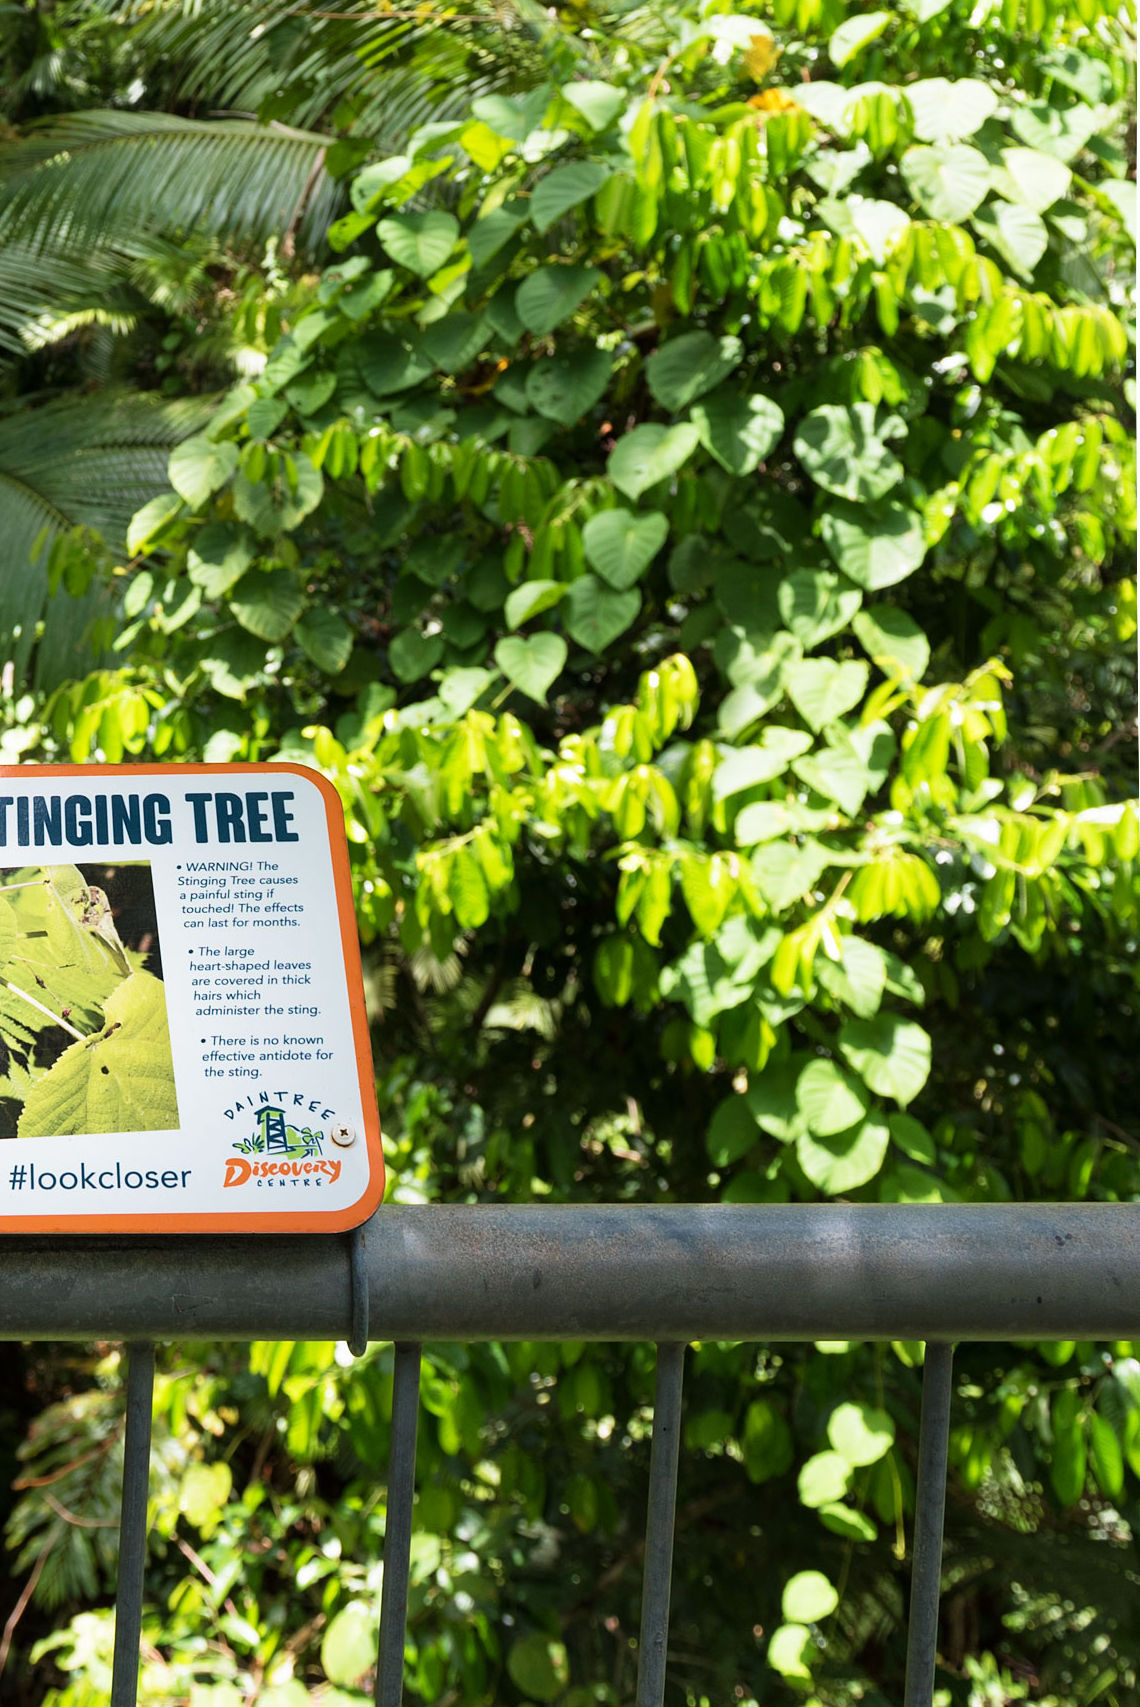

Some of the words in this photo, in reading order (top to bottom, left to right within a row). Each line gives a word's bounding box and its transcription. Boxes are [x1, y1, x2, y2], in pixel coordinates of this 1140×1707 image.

[184, 791, 300, 844] TREE
[186, 861, 253, 872] WARNING!
[256, 860, 279, 871] The
[177, 876, 227, 889] Stinging
[230, 875, 256, 885] Tree
[259, 877, 299, 885] causes
[189, 888, 231, 902] painful
[233, 889, 263, 902] sting
[266, 888, 275, 899] if
[181, 903, 234, 914] touched!
[238, 902, 261, 913] The
[264, 902, 304, 913] effects
[183, 920, 204, 928] can
[208, 917, 229, 928] last
[232, 916, 250, 928] for
[252, 916, 300, 927] months.
[198, 946, 221, 957] The
[224, 945, 255, 959] large
[189, 959, 270, 973] heart-shaped
[274, 959, 312, 970] leaves
[191, 978, 211, 986] are
[214, 974, 264, 986] covered
[267, 974, 278, 985] in
[281, 973, 311, 985] thick
[193, 990, 222, 1001] hairs
[225, 989, 261, 1000] which
[195, 1005, 261, 1016] administer
[264, 1004, 284, 1015] the
[287, 1004, 321, 1018] sting.
[210, 1035, 246, 1046] There
[250, 1035, 260, 1046] is
[263, 1037, 279, 1046] no
[283, 1034, 324, 1045] known
[202, 1050, 256, 1062] effective
[259, 1049, 312, 1061] antidote
[315, 1048, 334, 1060] for
[204, 1066, 225, 1077] the
[228, 1066, 263, 1080] sting.
[223, 1090, 336, 1121] DAINTREE
[8, 1161, 192, 1191] #lookcloser
[257, 1178, 322, 1187] CENTRE
